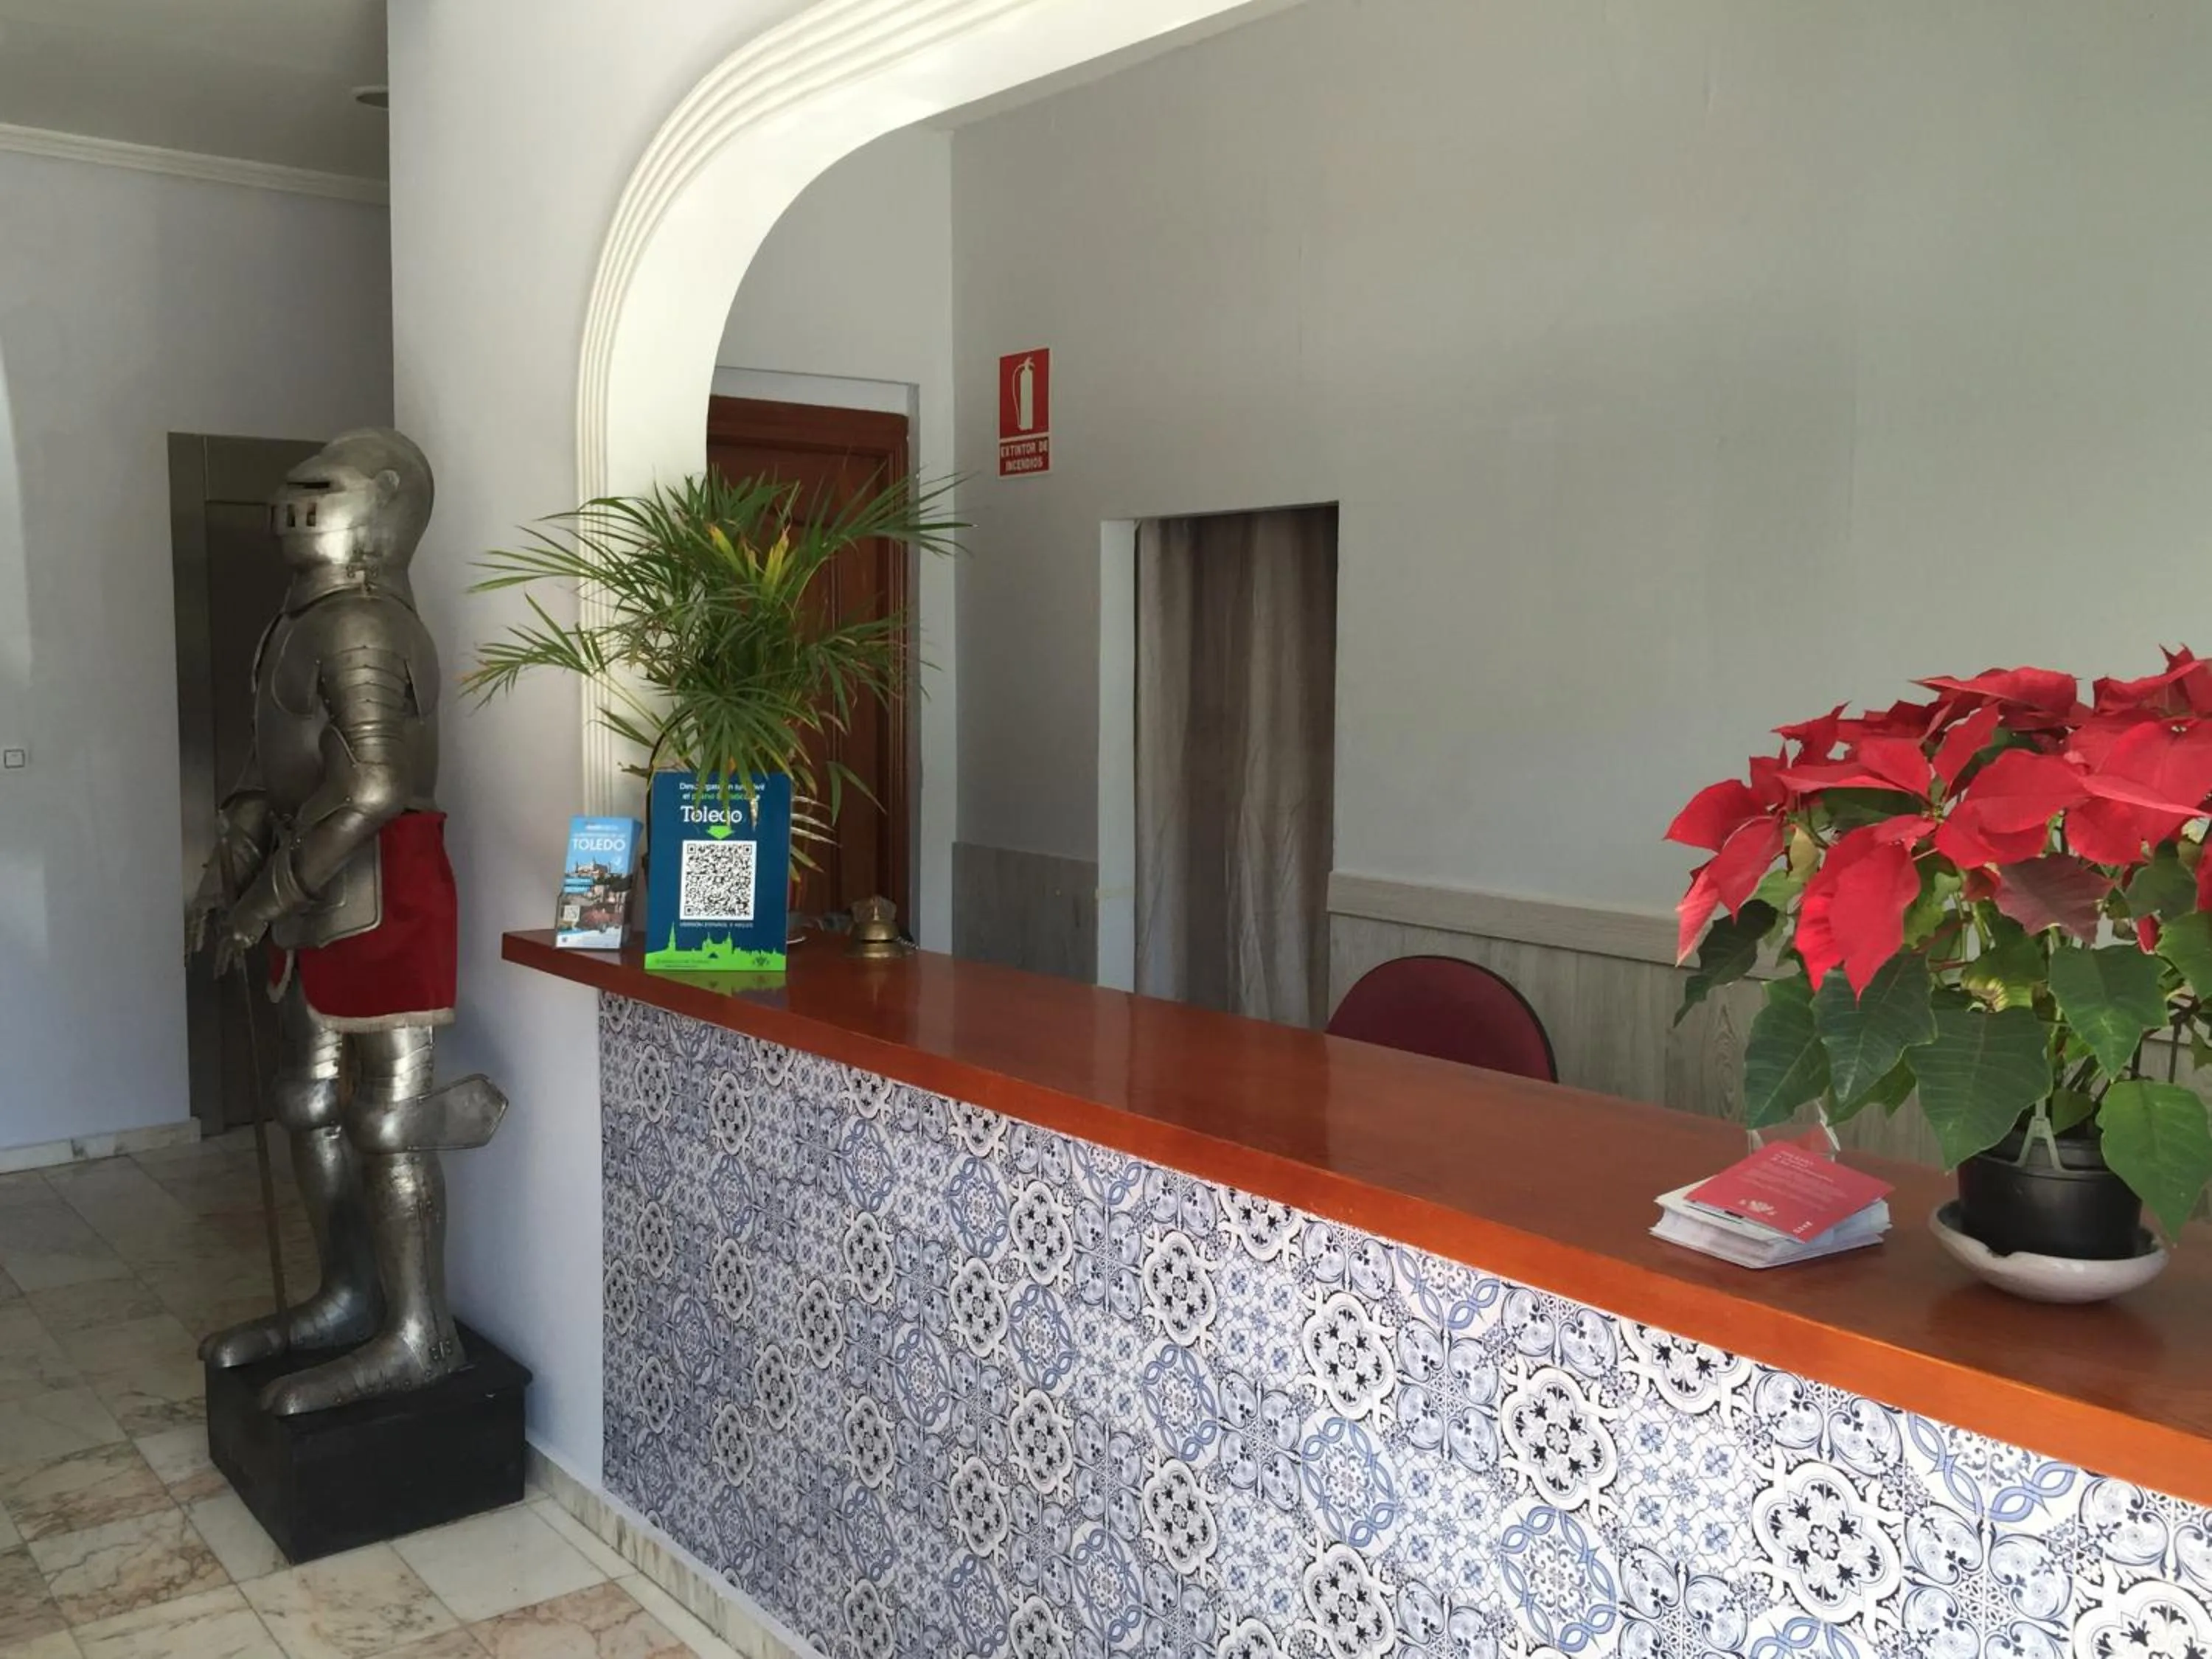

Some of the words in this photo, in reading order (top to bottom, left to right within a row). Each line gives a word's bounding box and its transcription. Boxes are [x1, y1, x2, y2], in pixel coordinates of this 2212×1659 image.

[1001, 442, 1036, 458] EXTINTOR
[1038, 439, 1047, 453] DE
[1005, 456, 1043, 472] INCENDIOS
[680, 805, 743, 823] Toledo
[572, 838, 626, 852] TOLEDO
